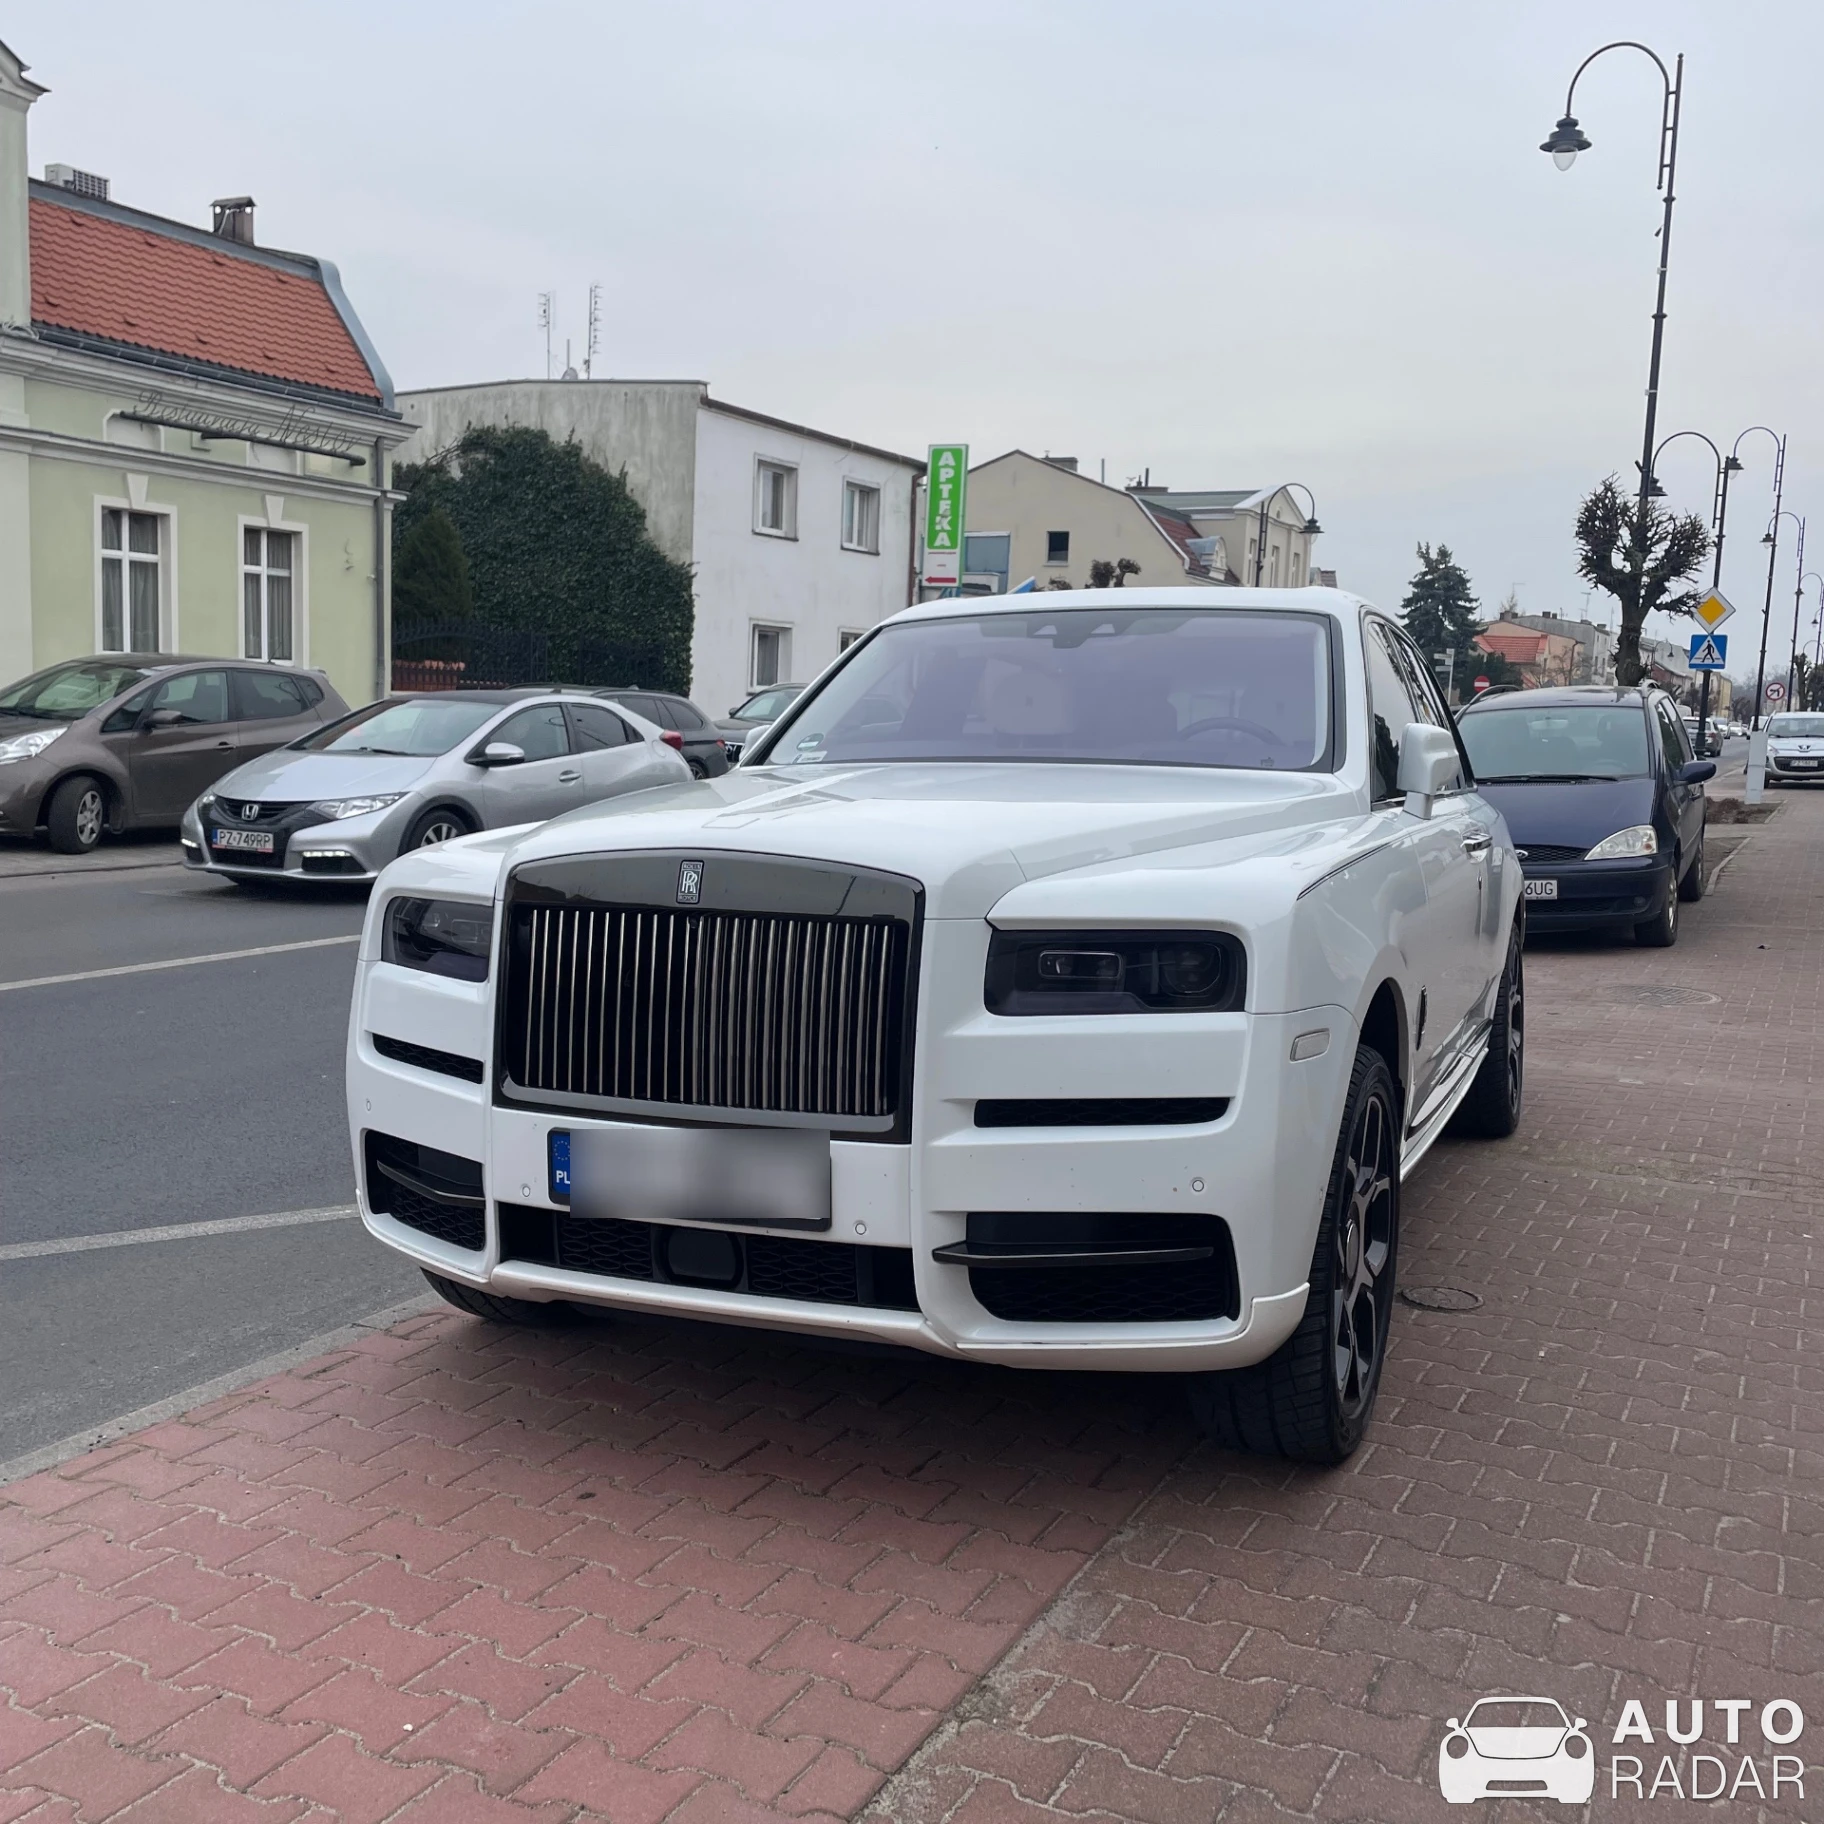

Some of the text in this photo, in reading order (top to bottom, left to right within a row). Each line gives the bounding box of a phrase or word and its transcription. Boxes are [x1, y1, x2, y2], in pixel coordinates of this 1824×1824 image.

[269, 404, 362, 452] Nestor
[934, 451, 956, 547] APTEKA
[219, 831, 271, 848] PZ 749RP
[556, 1170, 570, 1185] PL
